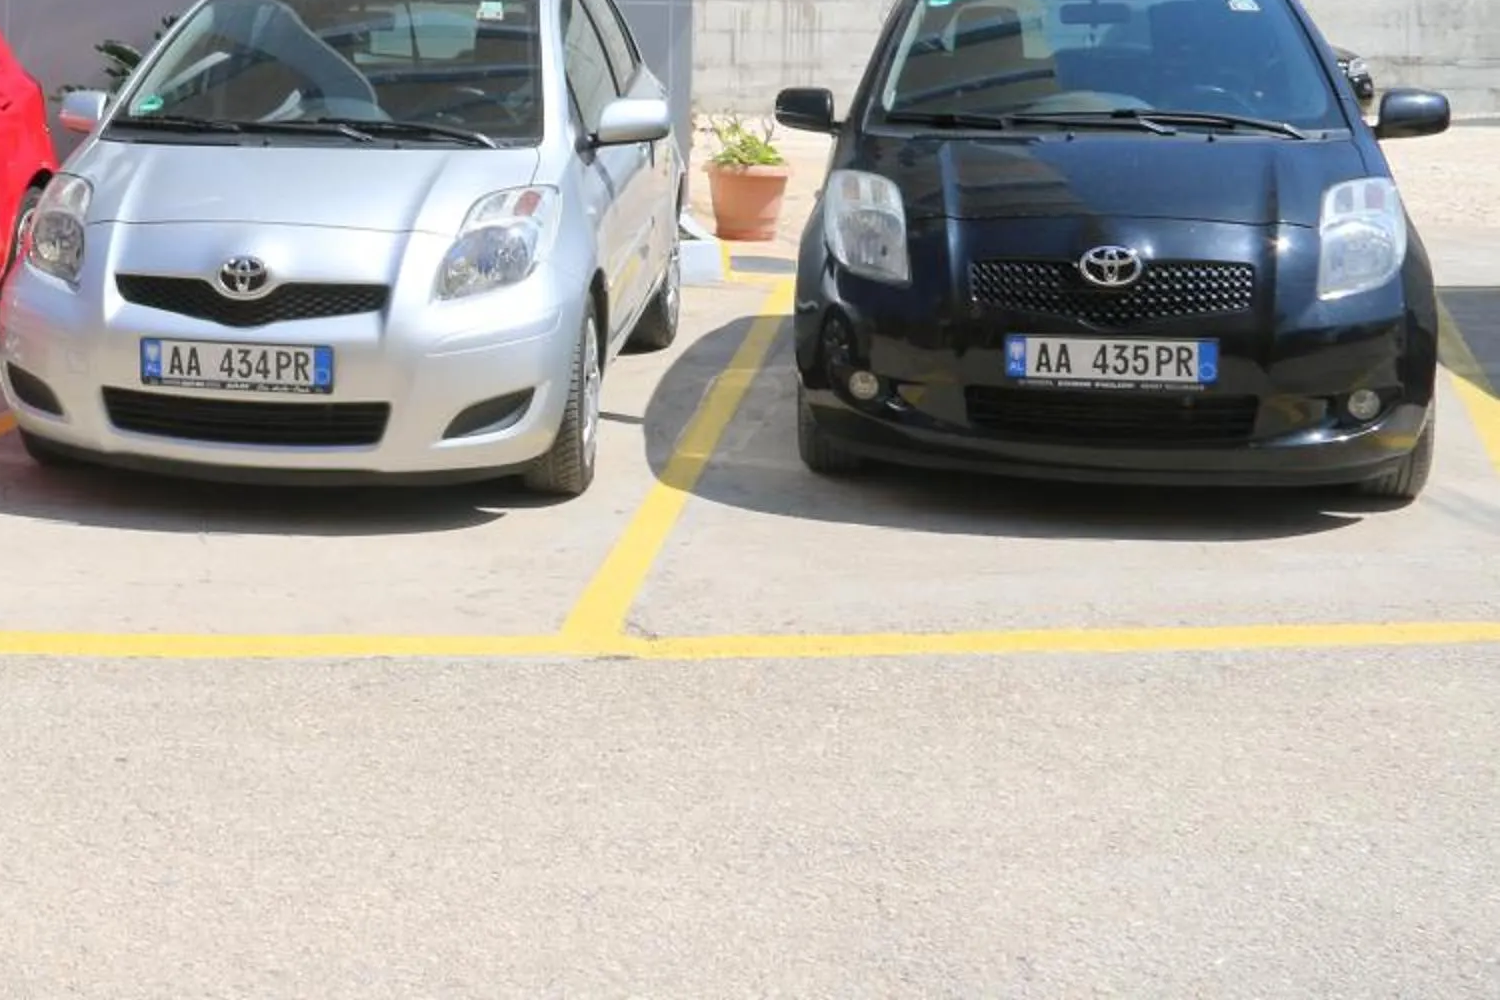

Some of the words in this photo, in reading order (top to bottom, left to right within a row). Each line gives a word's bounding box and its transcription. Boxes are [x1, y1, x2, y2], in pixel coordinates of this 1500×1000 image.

[169, 346, 202, 377] AA
[219, 348, 311, 381] 434PR
[1035, 342, 1073, 374] AA
[1091, 343, 1195, 377] 435PR
